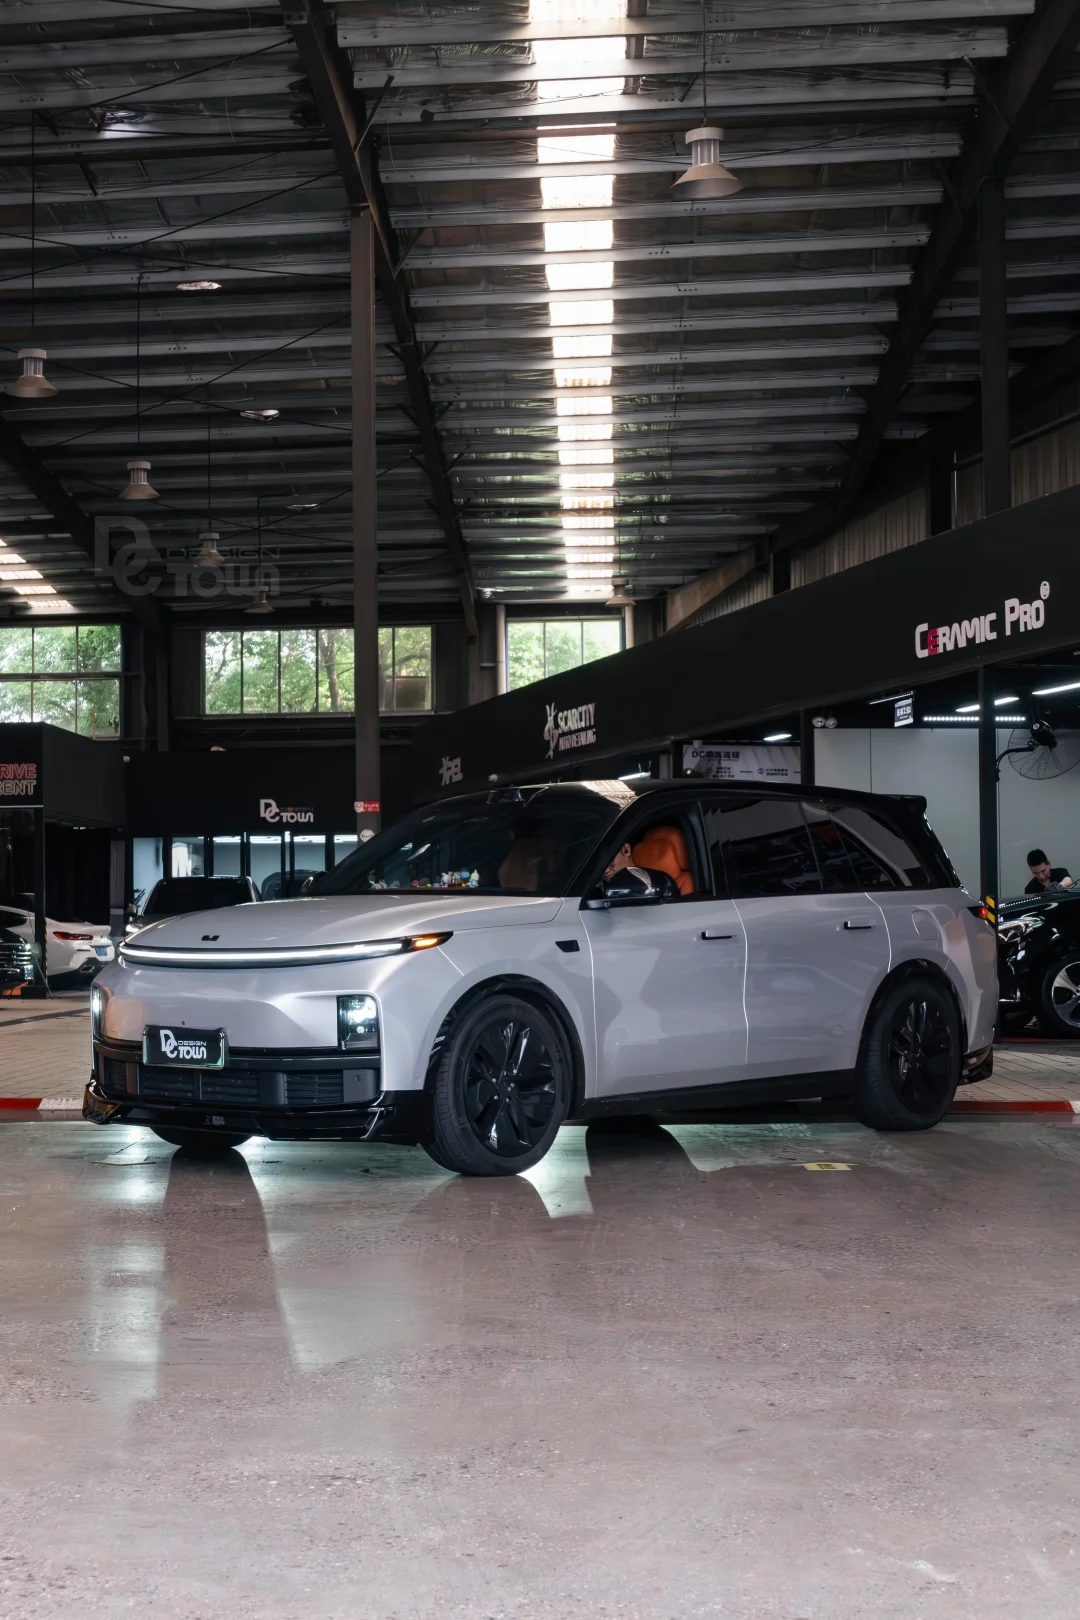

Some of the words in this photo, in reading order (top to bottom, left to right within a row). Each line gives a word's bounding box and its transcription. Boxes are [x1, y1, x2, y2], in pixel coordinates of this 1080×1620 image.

[914, 612, 998, 659] CERAMIC
[557, 702, 596, 734] SCARCITY
[260, 798, 280, 823] DC
[160, 1029, 178, 1059] DC
